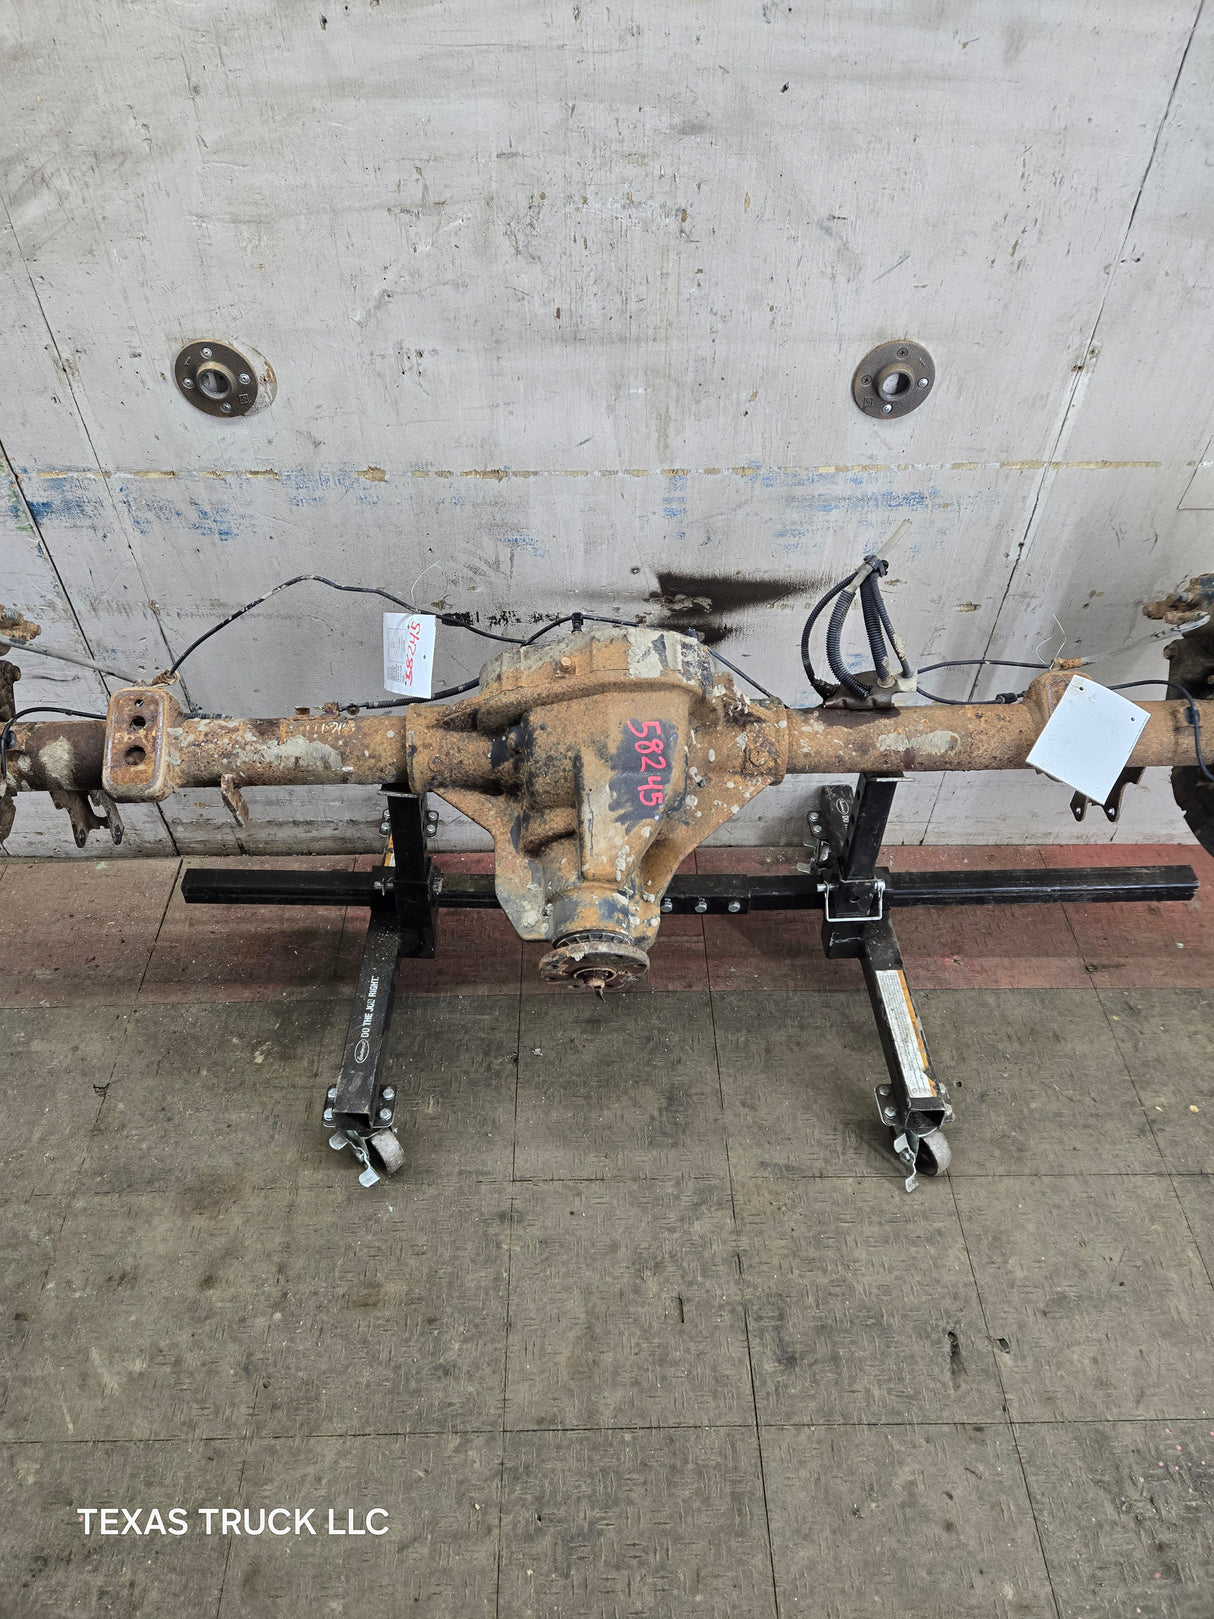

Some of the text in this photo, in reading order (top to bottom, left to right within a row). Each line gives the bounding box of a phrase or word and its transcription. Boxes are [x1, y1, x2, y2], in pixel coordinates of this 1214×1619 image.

[405, 620, 421, 686] 58245
[627, 720, 667, 806] 58245
[361, 1027, 371, 1038] DO
[362, 1012, 374, 1027] THE
